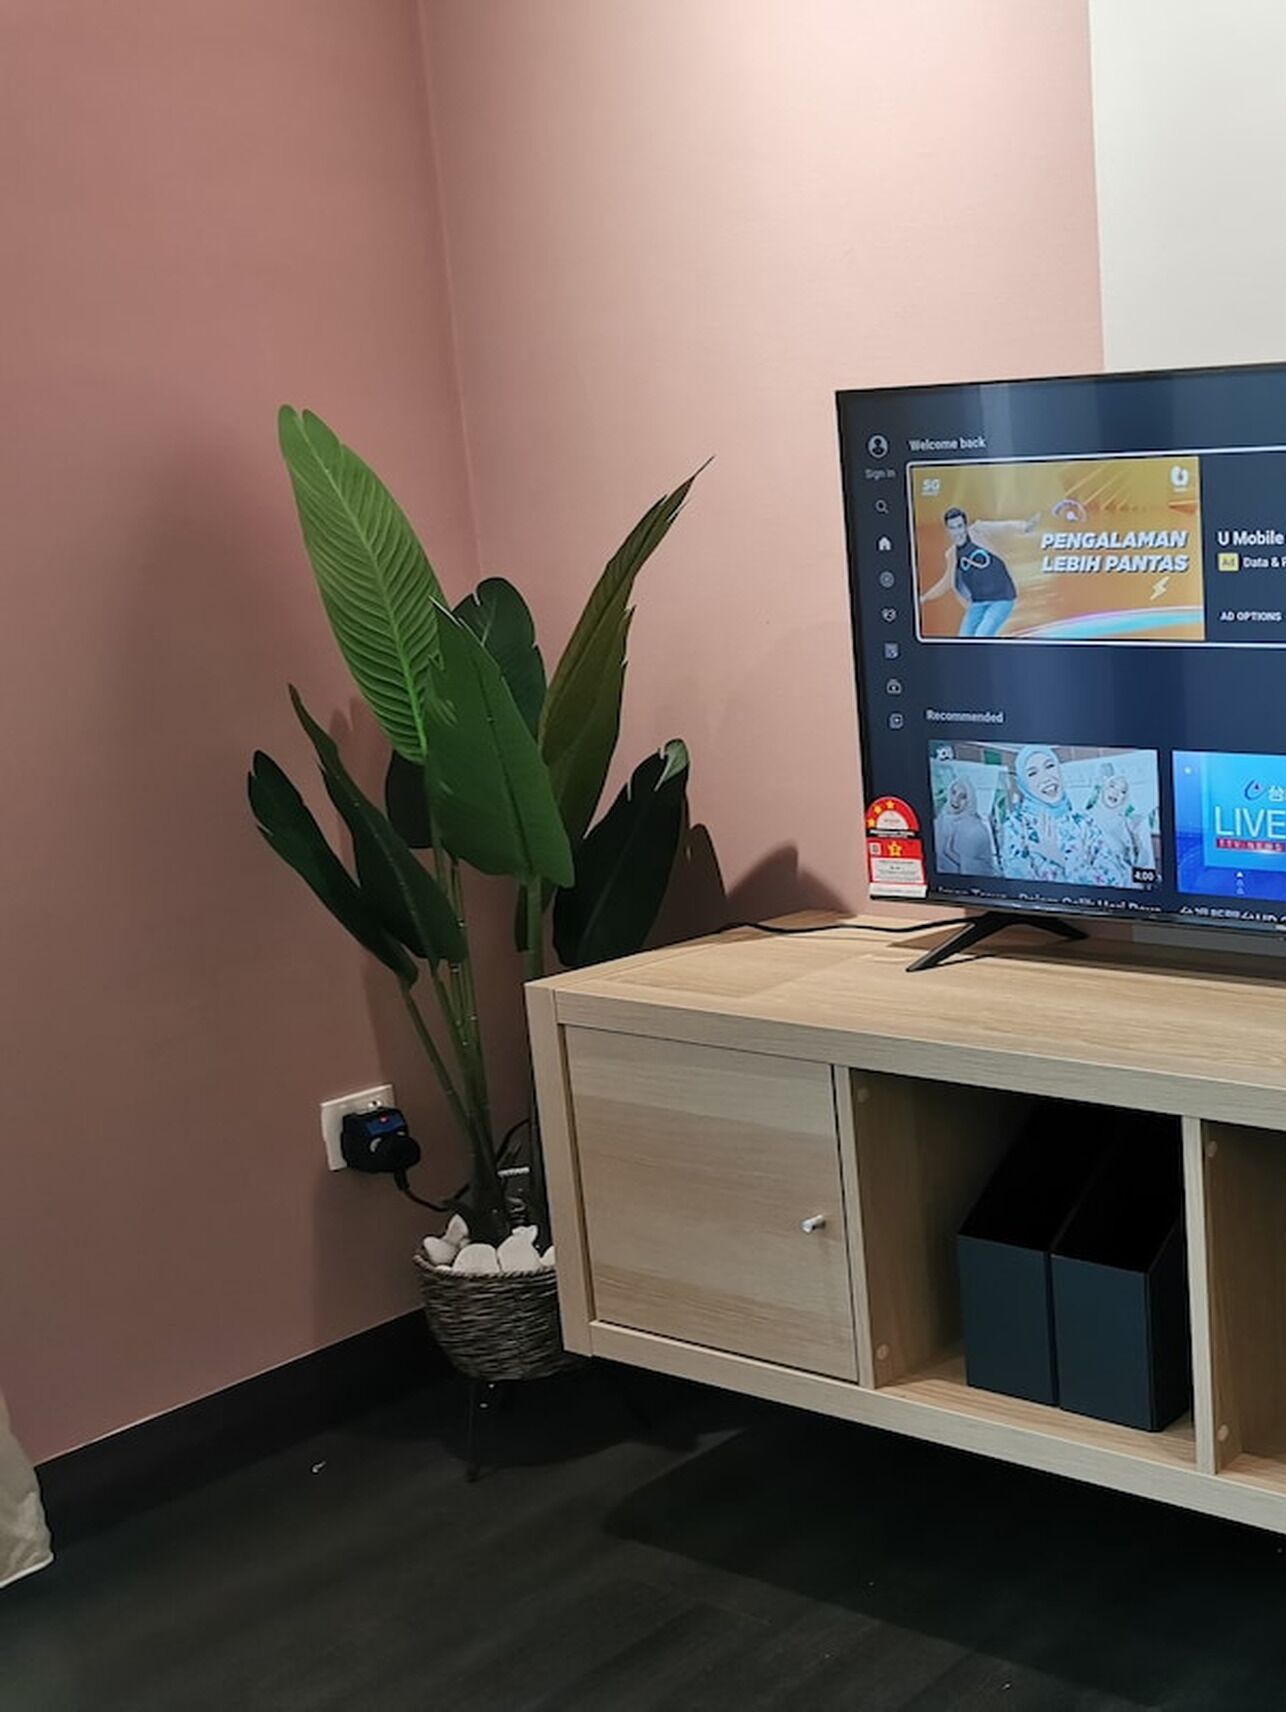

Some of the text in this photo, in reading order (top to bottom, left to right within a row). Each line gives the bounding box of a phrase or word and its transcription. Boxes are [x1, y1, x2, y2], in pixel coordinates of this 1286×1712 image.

[909, 436, 987, 451] Welcome back
[865, 469, 885, 480] Sign
[1041, 530, 1188, 550] PENGALAMAN
[1217, 531, 1230, 545] U
[1233, 530, 1284, 546] Mobile
[1042, 554, 1189, 573] LEBIH PANTAS
[1242, 557, 1269, 568] Data
[1270, 557, 1280, 568] &
[1219, 611, 1282, 621] AD OPTIONS
[926, 709, 1004, 723] Recommended
[1215, 806, 1286, 839] LIVE
